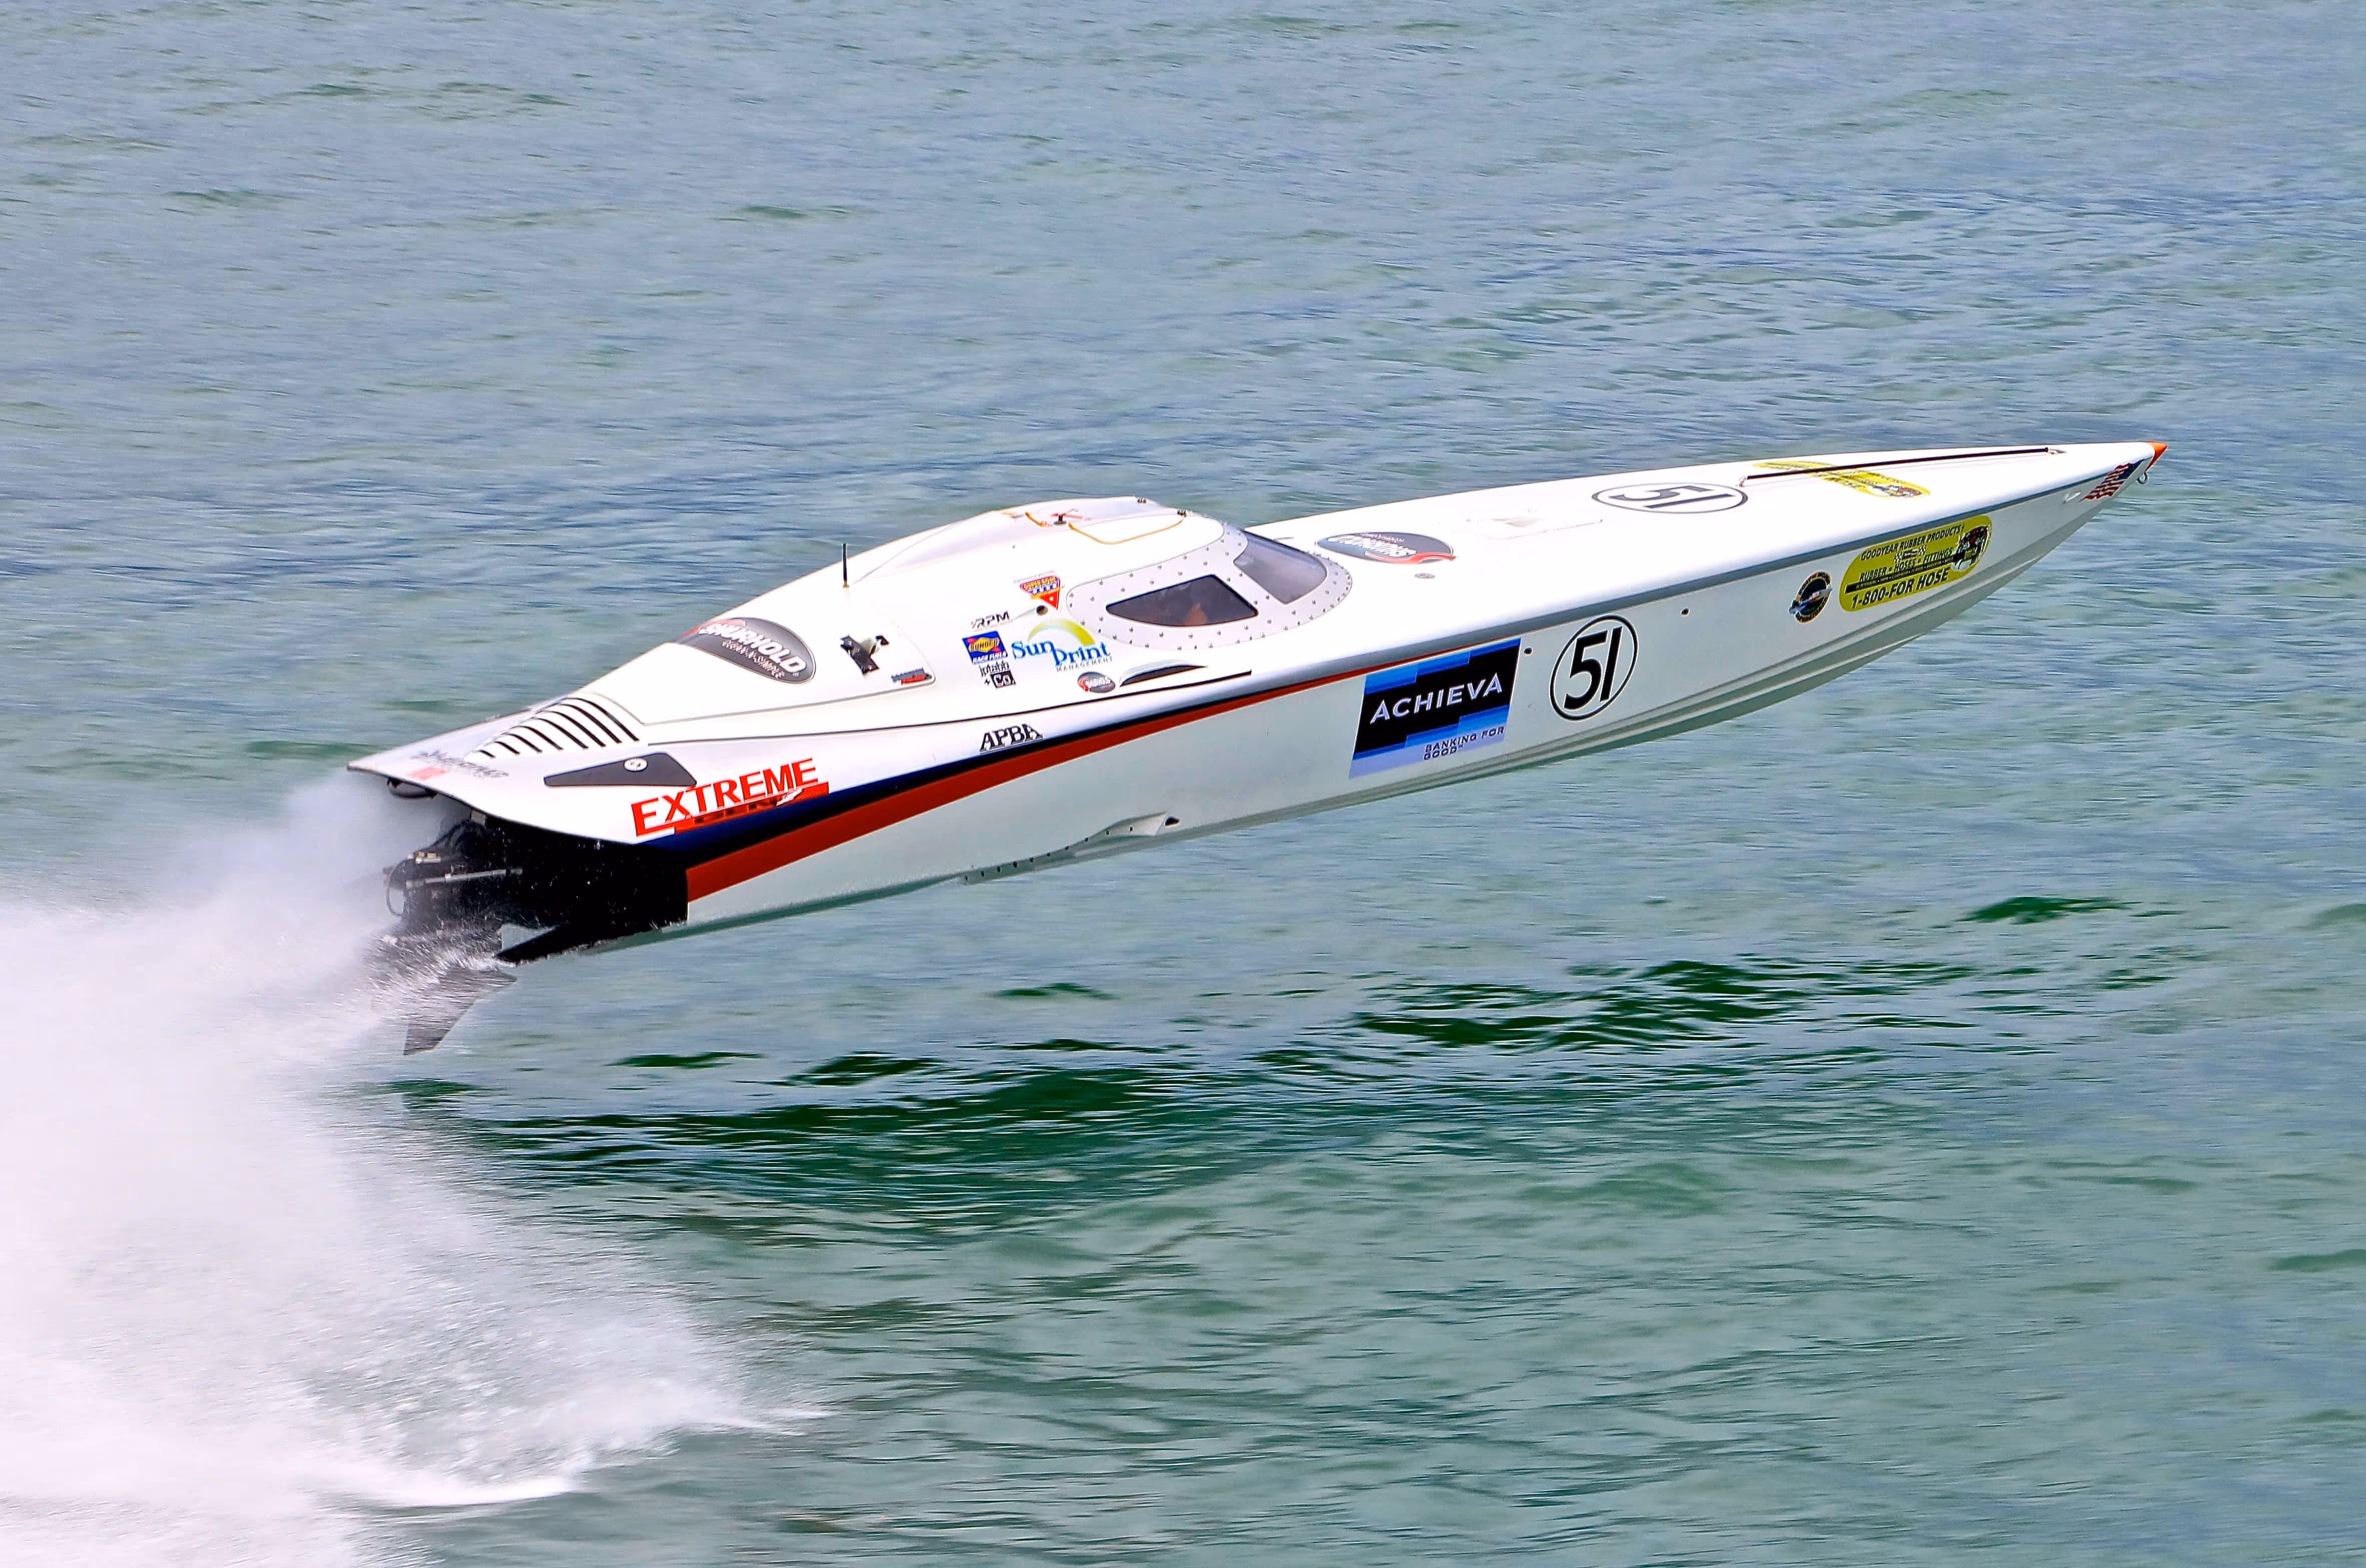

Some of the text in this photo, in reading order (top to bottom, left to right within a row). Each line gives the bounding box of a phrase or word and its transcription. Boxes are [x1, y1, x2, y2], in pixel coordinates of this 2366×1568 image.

[1860, 526, 1961, 561] GOODYEAR RUBBER PRODUCTS
[1859, 567, 1886, 581] RUBBER
[1894, 558, 1916, 573] HOSES
[1923, 547, 1953, 564] FITTINGS
[1851, 579, 1914, 609] 1-800-FOR
[1916, 567, 1950, 591] HOSE
[1056, 657, 1113, 673] MANAGEMENT
[1564, 626, 1623, 711] 51
[1369, 672, 1503, 725] ACHIEVA
[979, 723, 1044, 752] APBA
[1425, 726, 1505, 752] BANKING FOR
[631, 757, 819, 837] EXTREME
